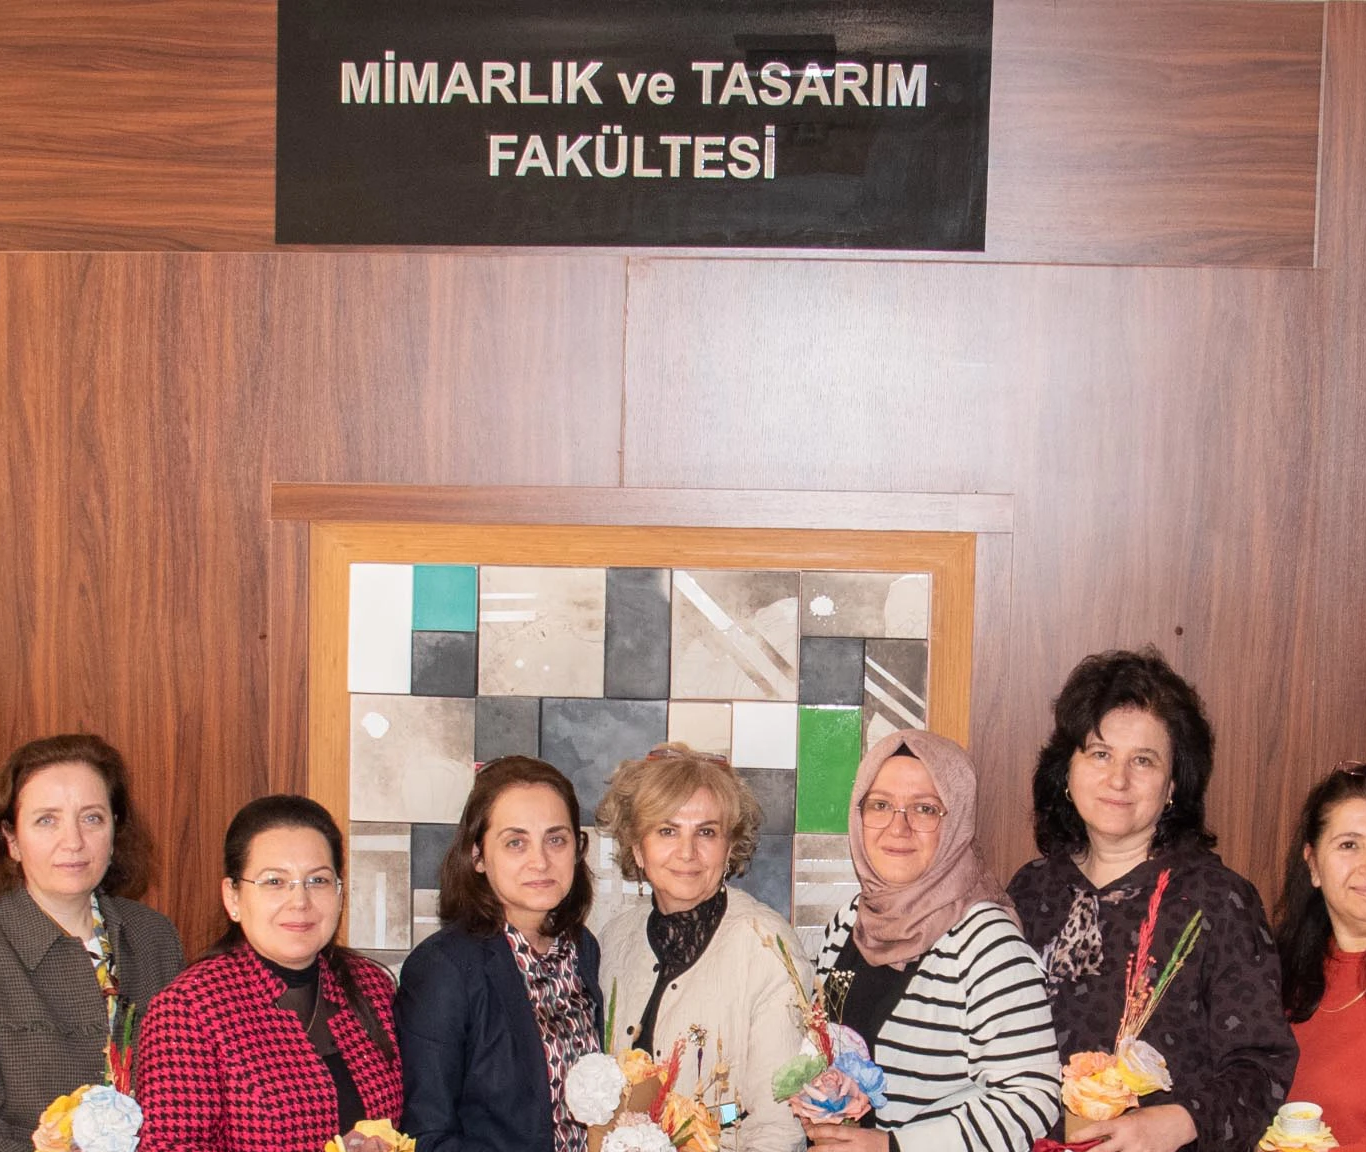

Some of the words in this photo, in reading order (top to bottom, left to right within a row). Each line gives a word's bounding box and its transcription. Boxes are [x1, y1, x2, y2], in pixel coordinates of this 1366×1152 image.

[340, 50, 604, 105] MİMARLIK
[616, 71, 676, 106] ve
[691, 61, 928, 108] TASARIM
[489, 124, 776, 180] FAKÜLTESİ
